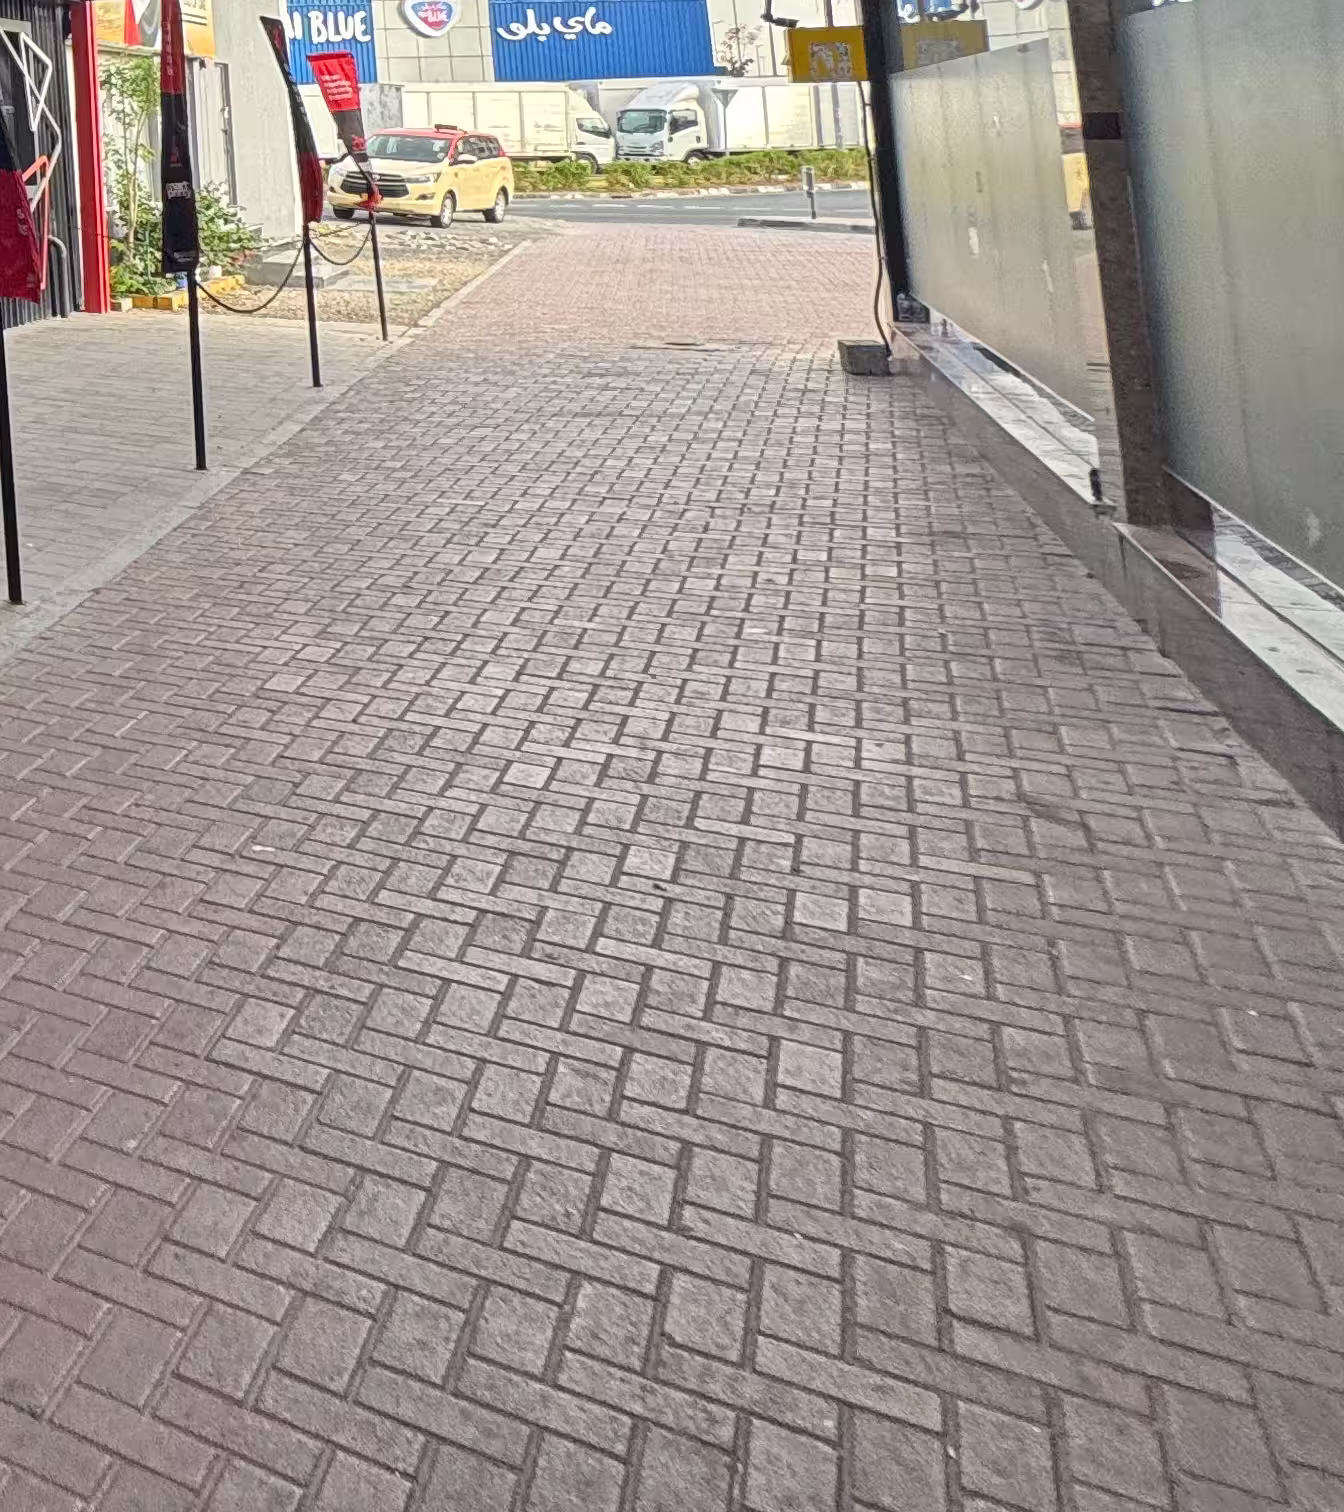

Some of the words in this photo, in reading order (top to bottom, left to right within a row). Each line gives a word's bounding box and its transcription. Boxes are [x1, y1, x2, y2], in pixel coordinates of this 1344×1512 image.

[308, 10, 371, 44] BLUE
[496, 8, 551, 42] بلو
[553, 7, 612, 40] ماي
